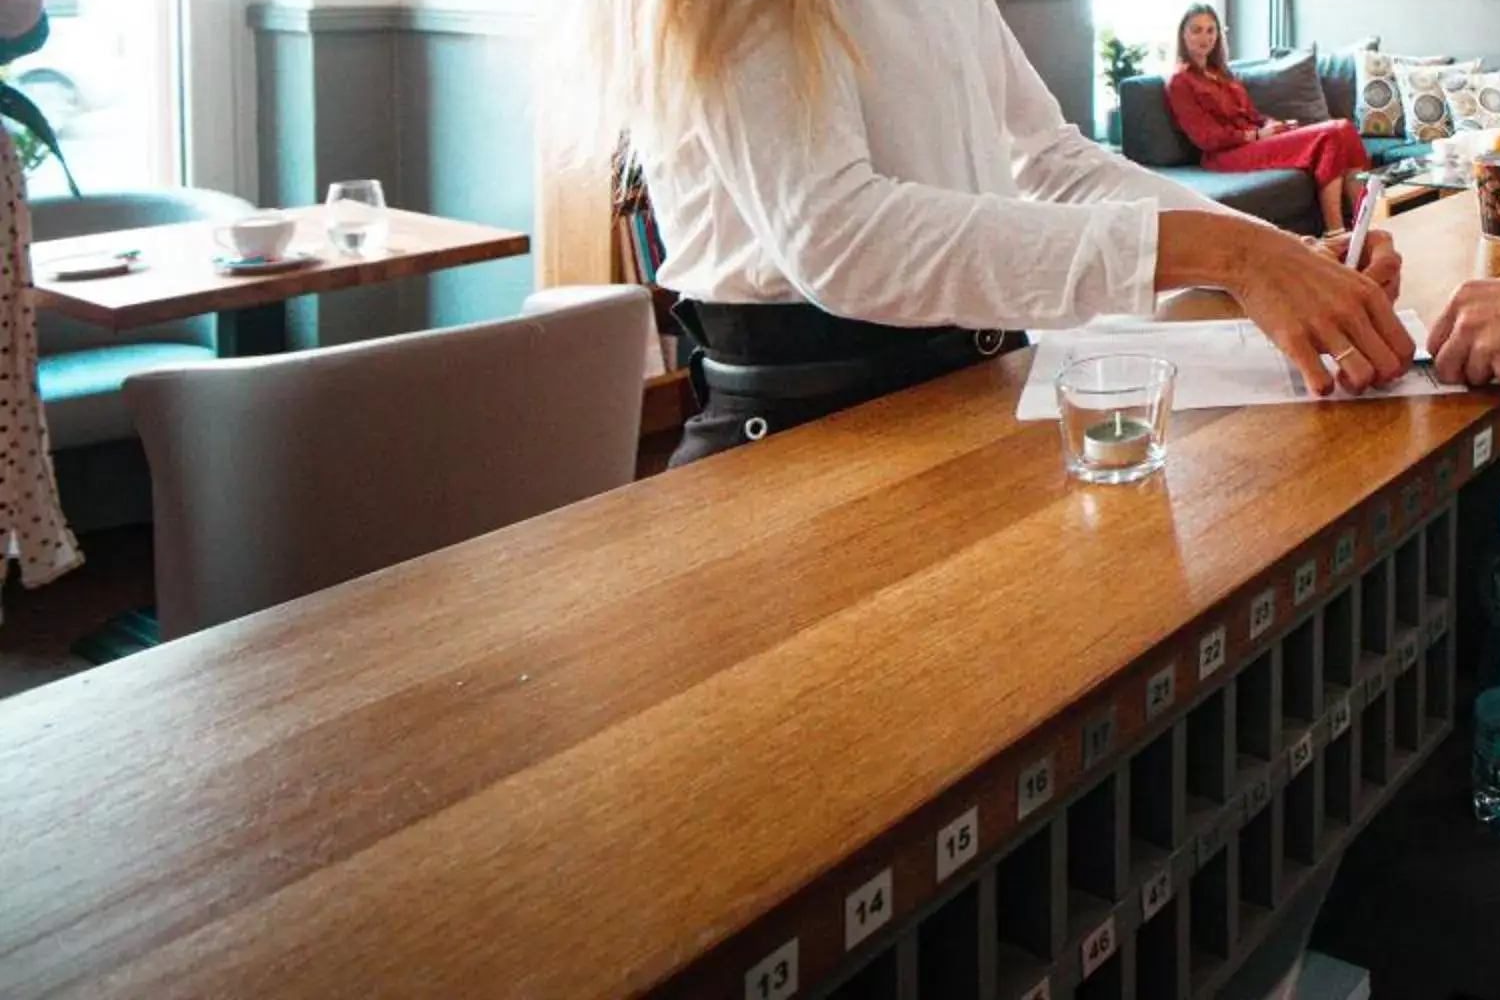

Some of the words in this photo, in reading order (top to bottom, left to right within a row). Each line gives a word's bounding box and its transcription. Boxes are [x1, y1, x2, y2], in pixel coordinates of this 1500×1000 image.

[1203, 639, 1220, 665] 22
[1150, 676, 1168, 706] 21
[1091, 721, 1111, 754] 17
[1025, 768, 1047, 800] 16
[944, 825, 969, 859] 15
[854, 888, 883, 925] 14
[1088, 929, 1109, 960] 46
[757, 960, 789, 999] 13
